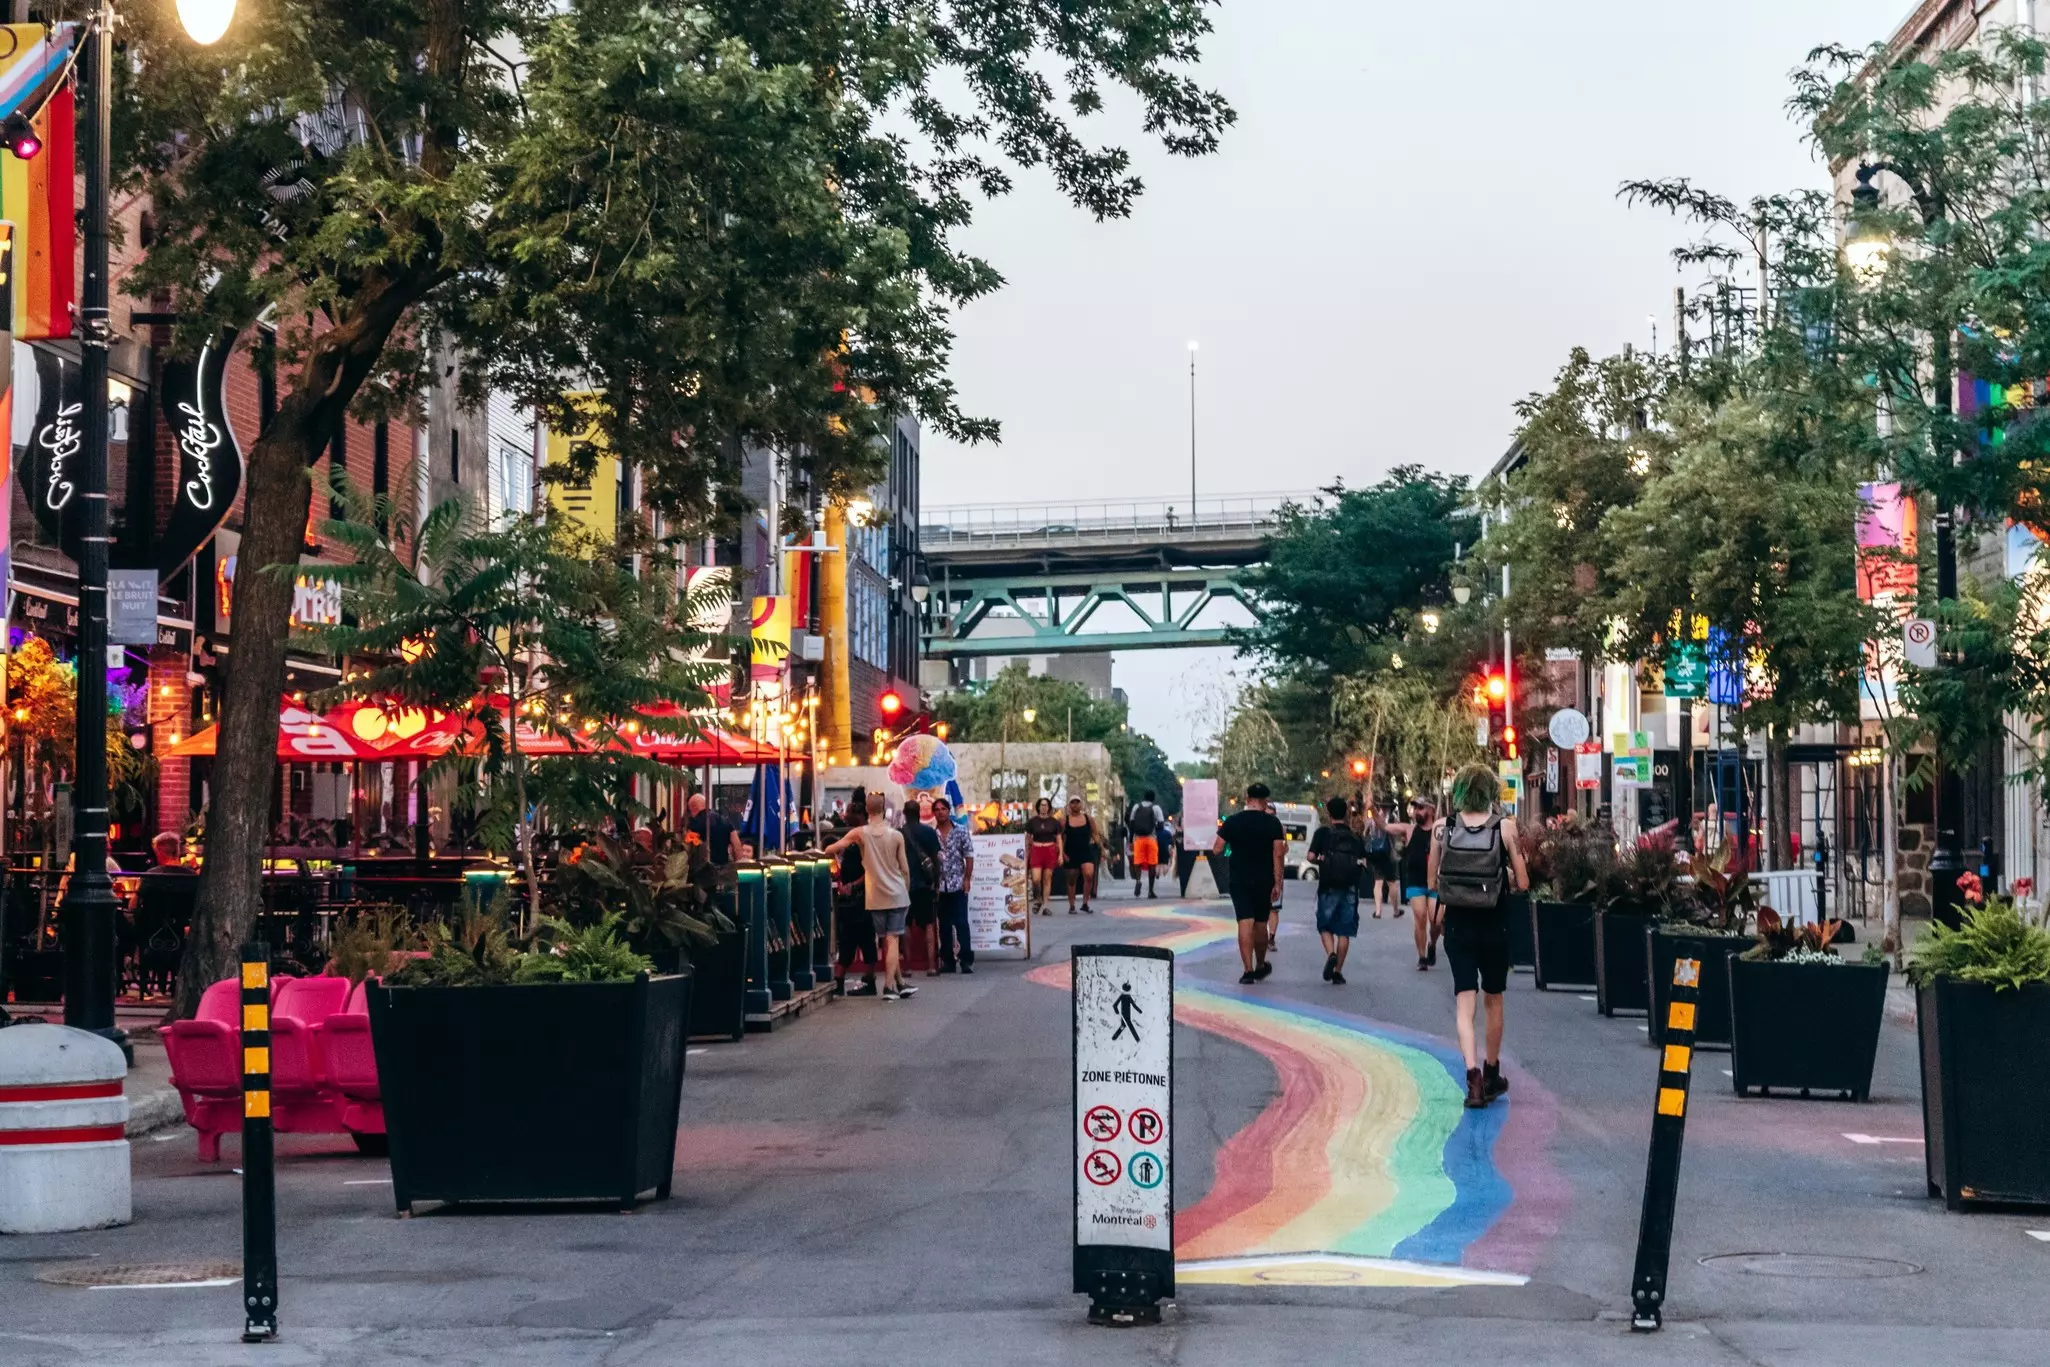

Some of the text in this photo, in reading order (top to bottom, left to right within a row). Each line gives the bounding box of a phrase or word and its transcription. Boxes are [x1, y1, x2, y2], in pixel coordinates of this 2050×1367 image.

[178, 334, 221, 510] Cocktail
[112, 580, 125, 590] LA
[111, 591, 155, 600] LE BRUIT
[122, 602, 147, 610] NUIT
[1653, 765, 1669, 776] 00
[1082, 1069, 1167, 1087] ZONE PIÉTONNE
[1092, 1213, 1142, 1226] Montréal
